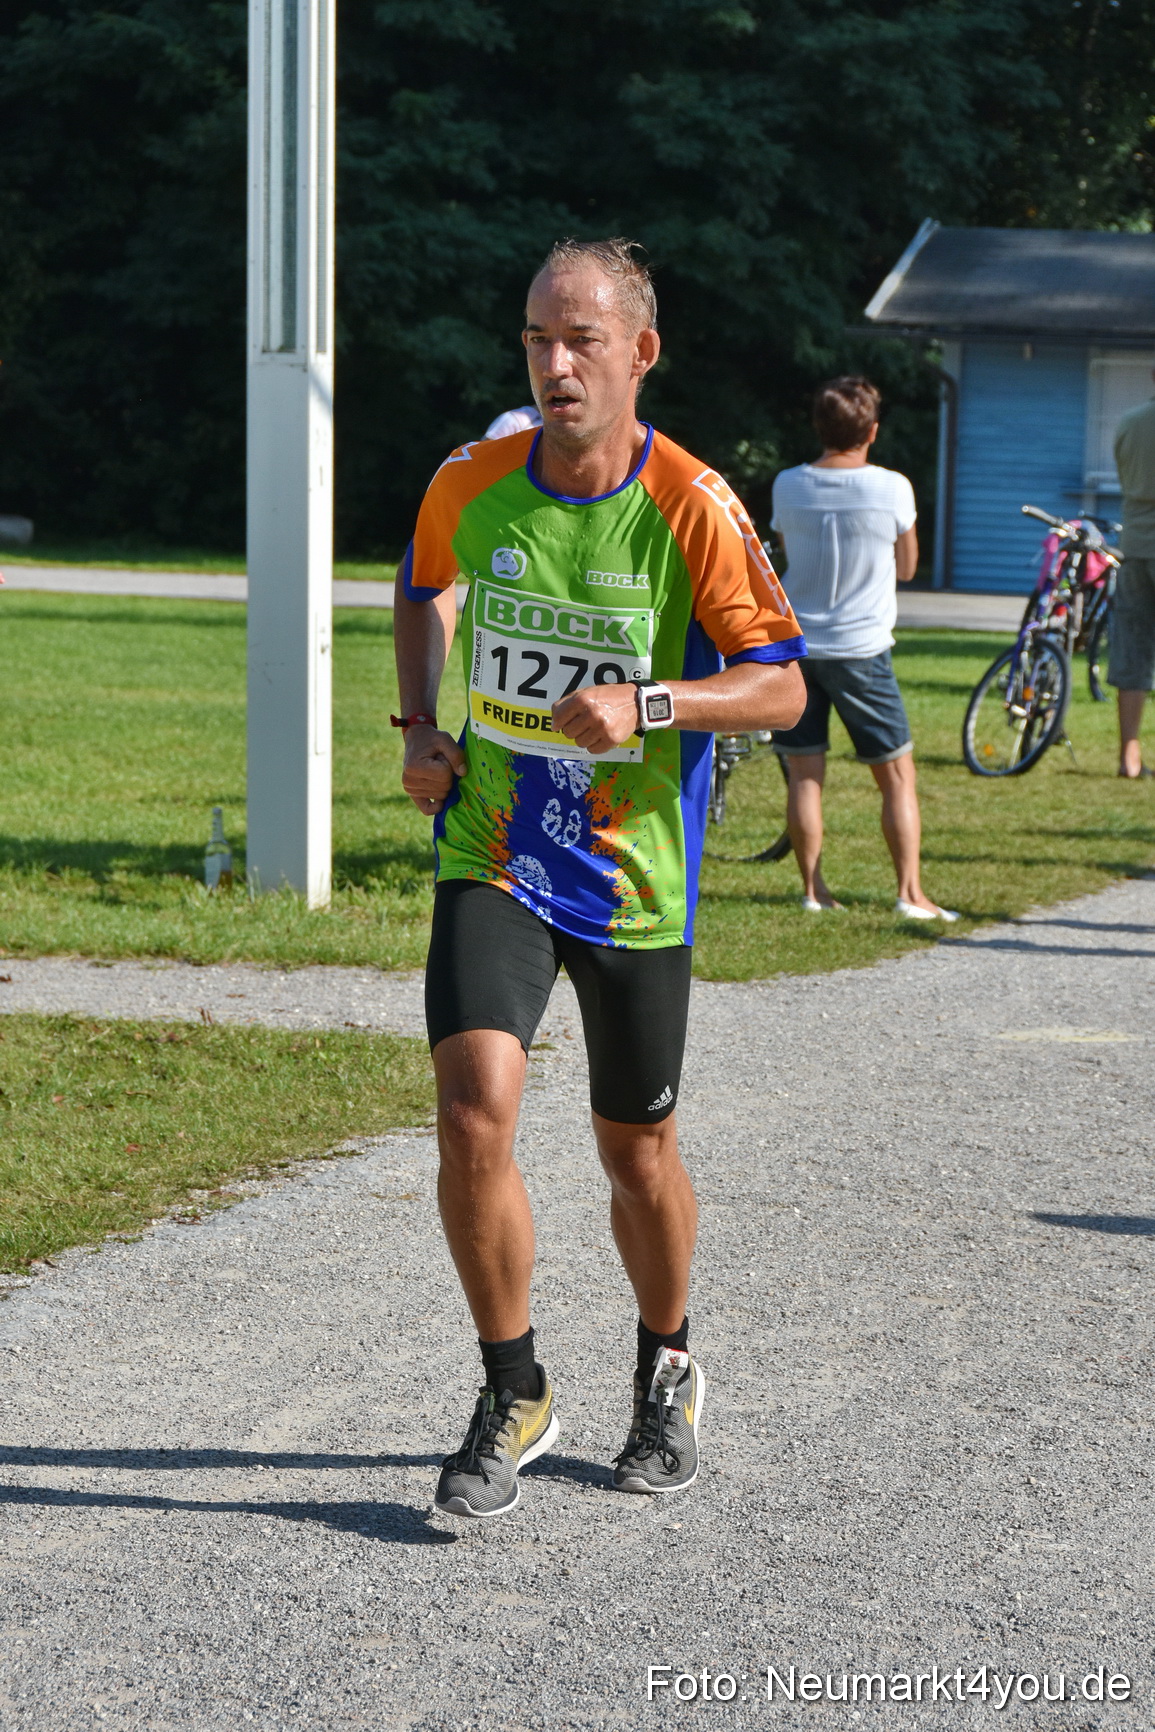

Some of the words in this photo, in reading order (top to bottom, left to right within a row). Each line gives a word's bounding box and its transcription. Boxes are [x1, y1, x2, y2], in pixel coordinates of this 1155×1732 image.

[586, 570, 649, 589] BOCK
[485, 590, 635, 652] BOCK
[482, 701, 564, 734] FRIEDE
